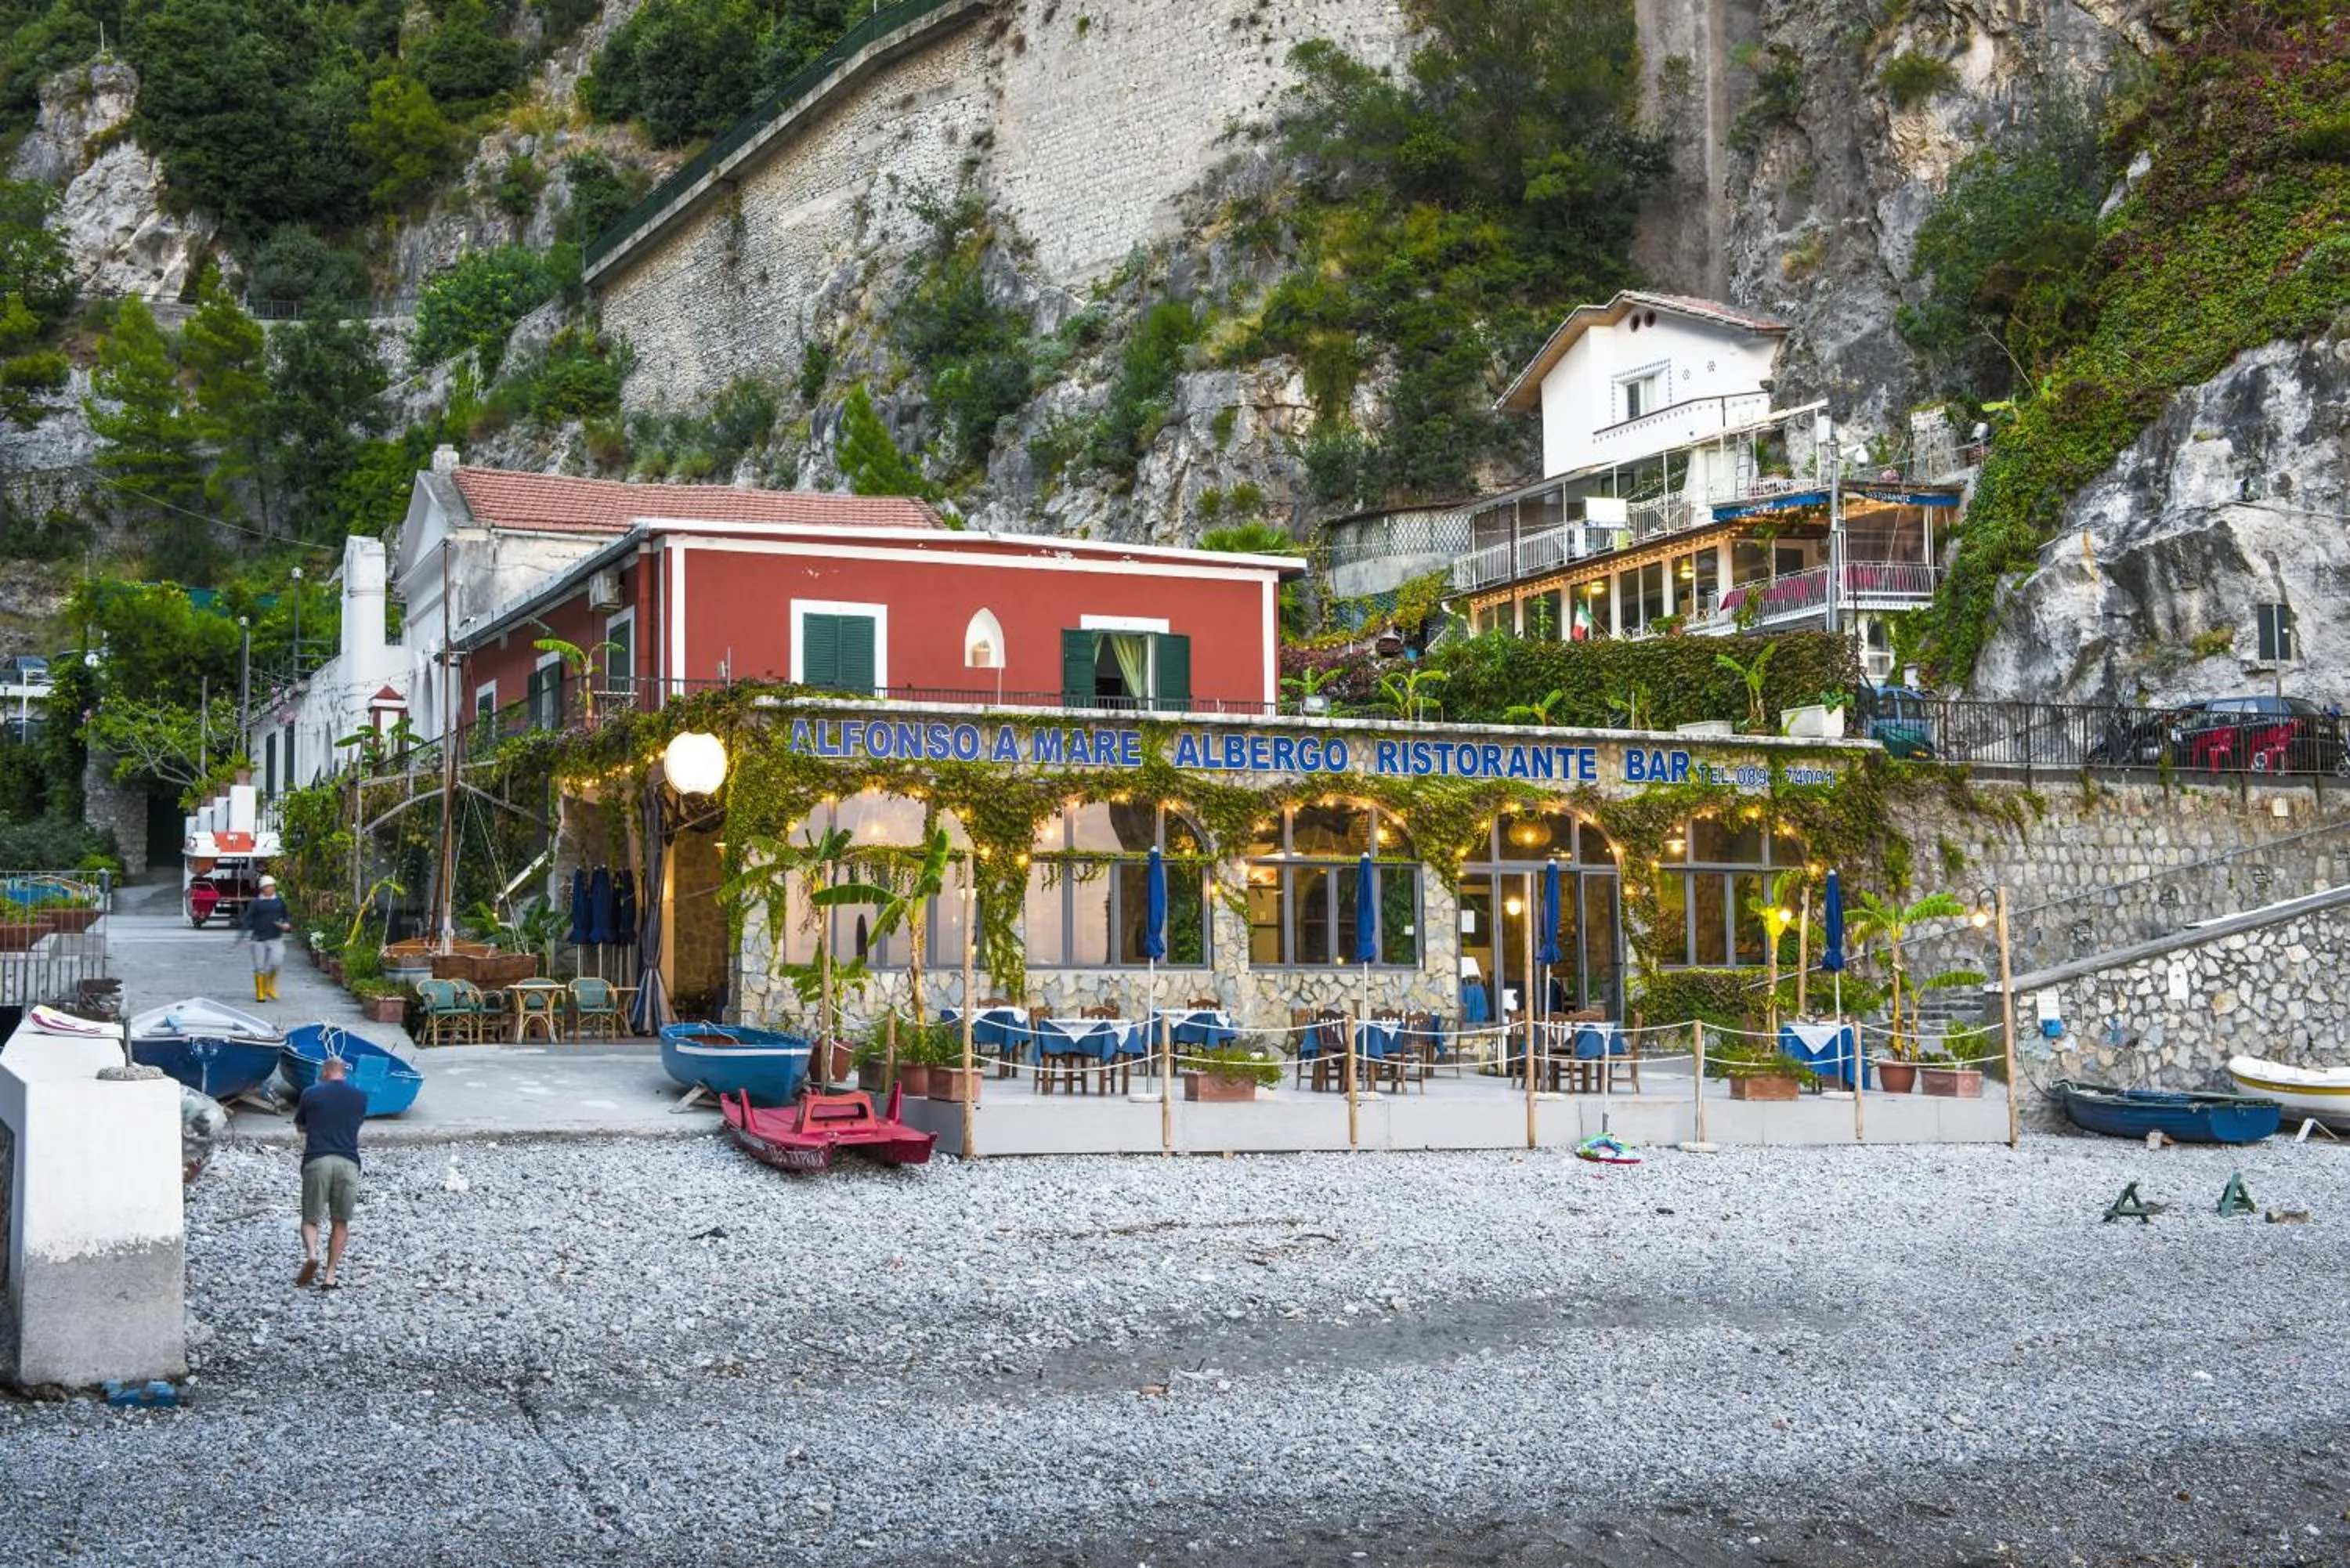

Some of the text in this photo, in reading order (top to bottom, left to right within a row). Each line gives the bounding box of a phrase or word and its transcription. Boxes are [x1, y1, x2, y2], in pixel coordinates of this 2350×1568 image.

[788, 718, 980, 761] ALFONSO
[992, 724, 1021, 762] A
[1032, 727, 1143, 767] MARE
[1175, 732, 1350, 772] ALBERGO
[1376, 740, 1597, 780] RISTORANTE
[1625, 748, 1691, 783] BAR
